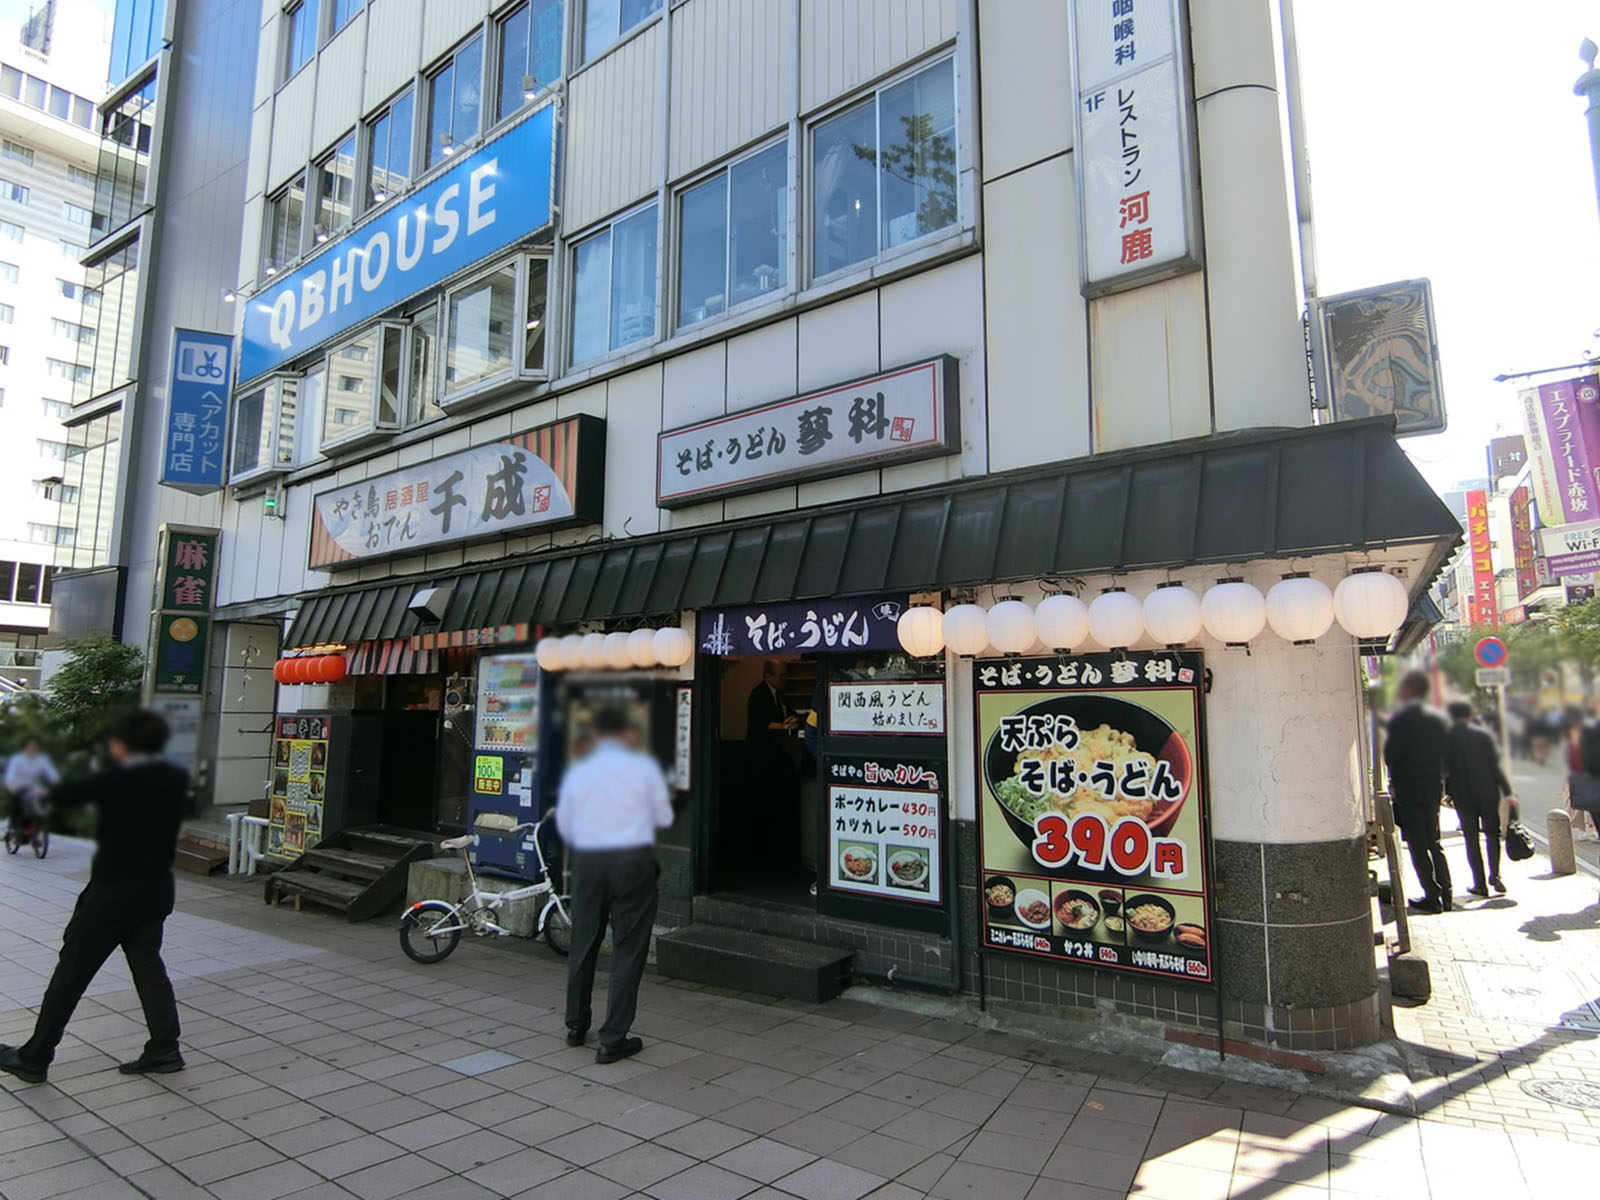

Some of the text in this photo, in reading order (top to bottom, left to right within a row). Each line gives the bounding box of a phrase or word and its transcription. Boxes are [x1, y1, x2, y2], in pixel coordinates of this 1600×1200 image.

[1085, 92, 1106, 113] 1F
[1117, 89, 1142, 188] レストラン
[1119, 190, 1153, 265] 河鹿
[170, 412, 198, 473] 専門店
[199, 390, 223, 474] ヘアカット
[1549, 390, 1589, 513] エスプラナード赤坂
[333, 484, 380, 521] やき鳥
[385, 480, 429, 511] 居酒屋
[430, 451, 528, 534] 千成
[366, 512, 417, 549] おでん
[1469, 502, 1491, 572] パチンコ
[1564, 530, 1590, 541] FREE
[173, 539, 208, 606] 麻雀
[744, 609, 869, 651] そば・うどん
[978, 660, 1102, 686] そば・うどん
[838, 689, 931, 709] 関西風うどん
[872, 711, 929, 727] 始めました
[1000, 714, 1079, 751] 天ぷら
[1021, 759, 1182, 801] そば・うどん
[836, 817, 900, 835] カツカレー
[1034, 813, 1187, 878] 390円
